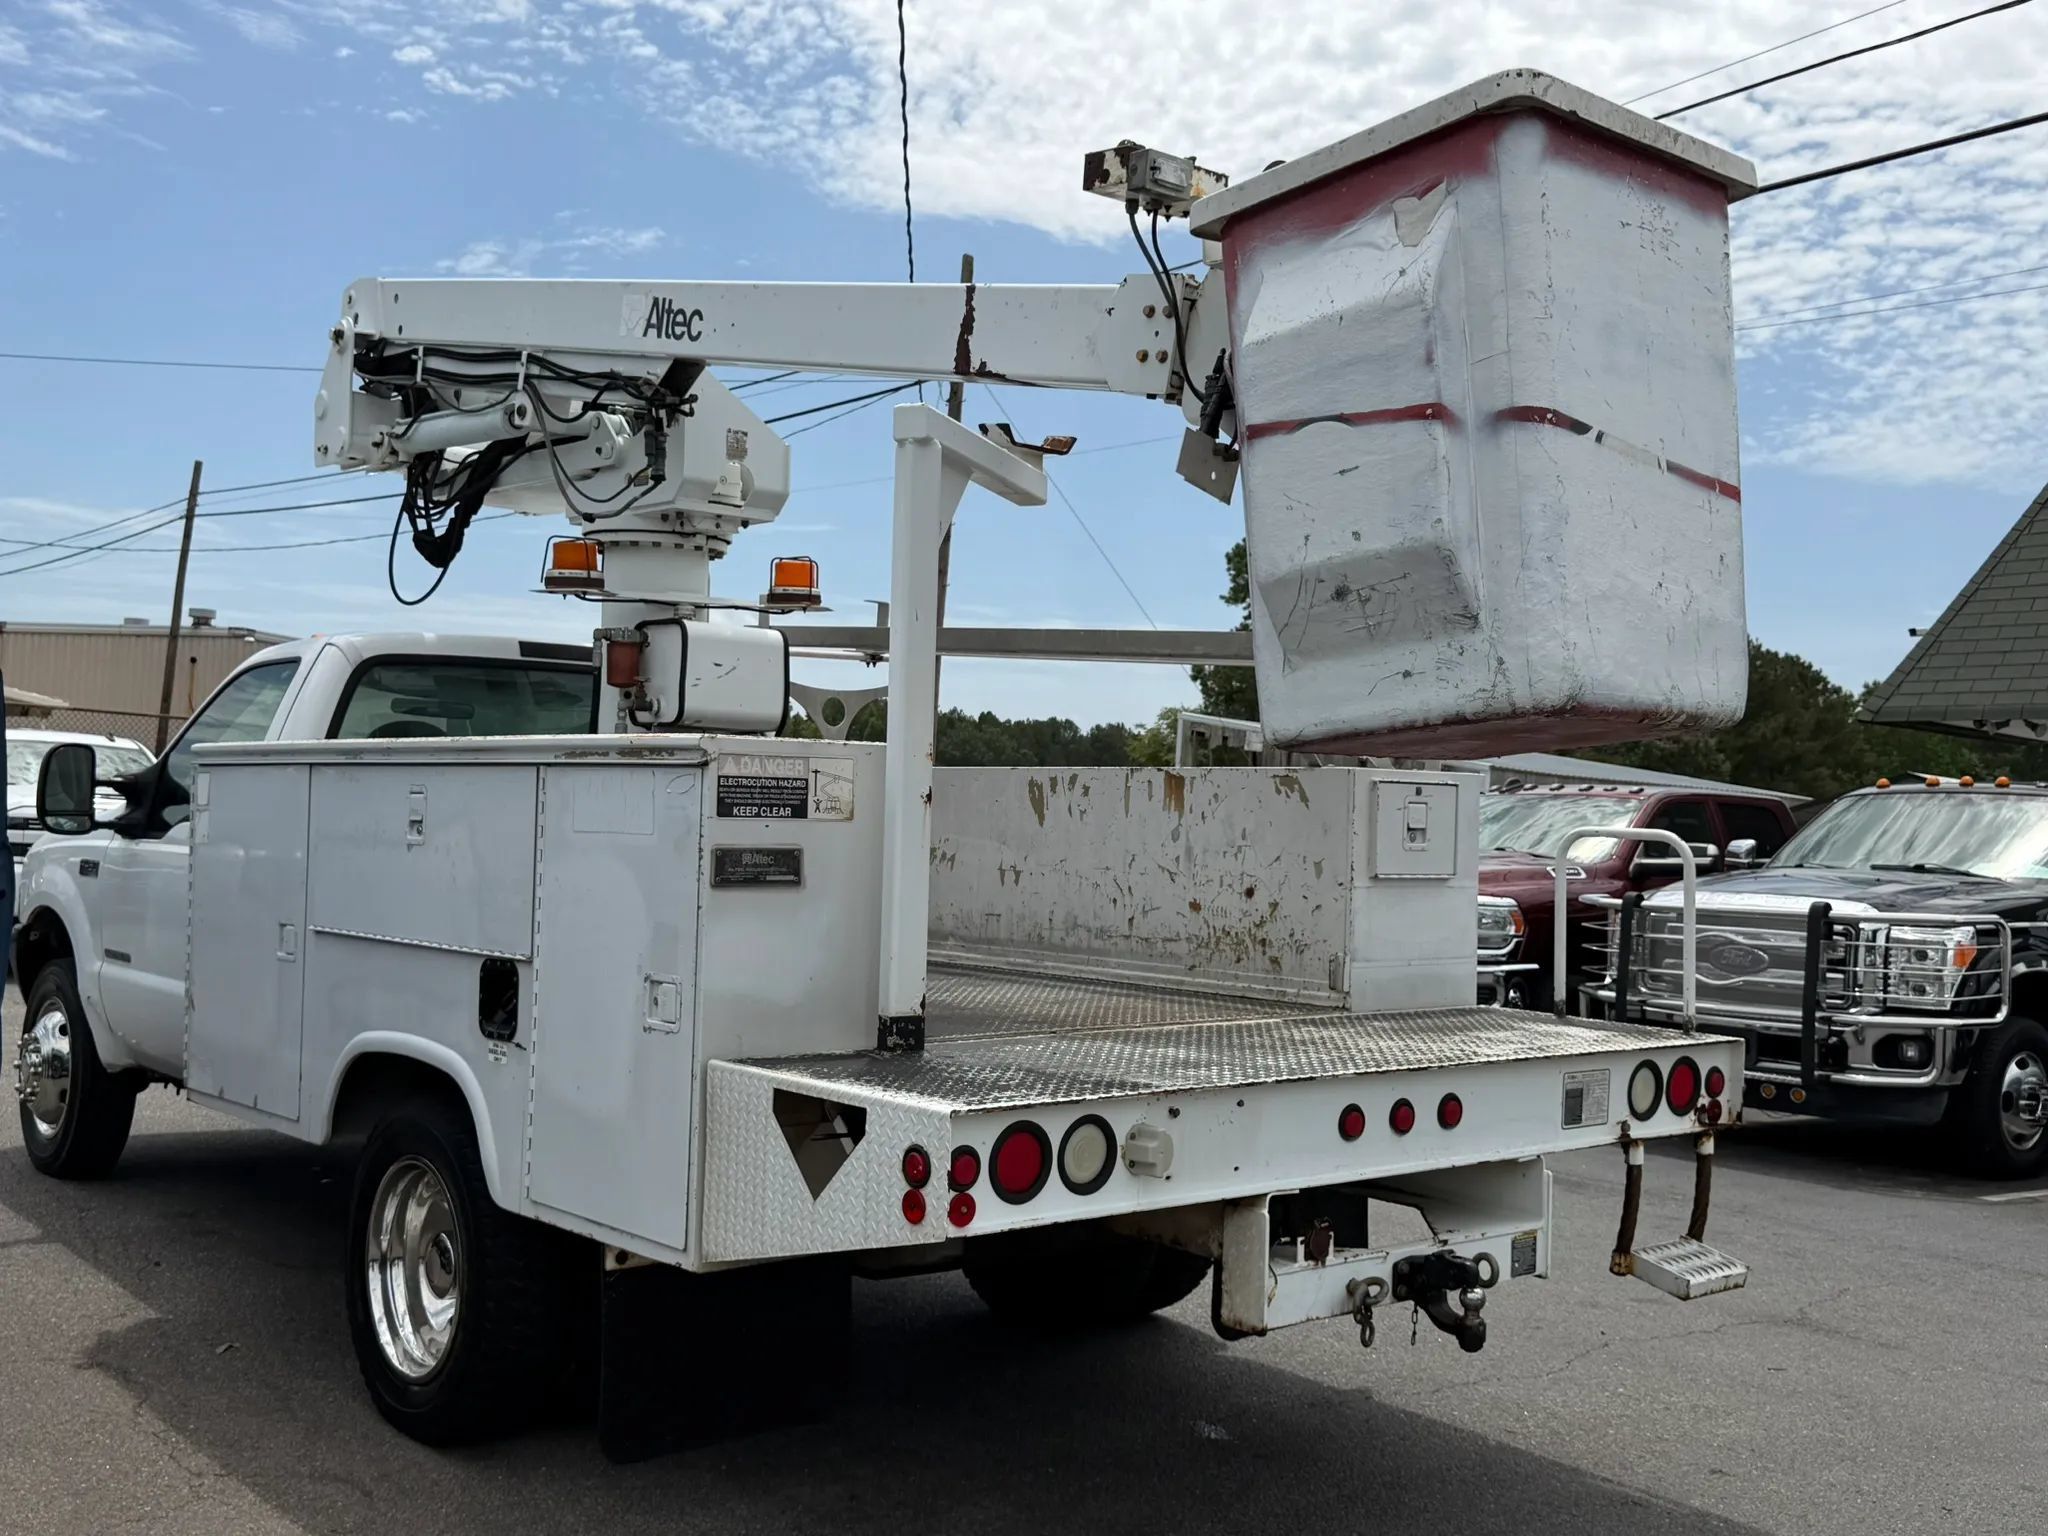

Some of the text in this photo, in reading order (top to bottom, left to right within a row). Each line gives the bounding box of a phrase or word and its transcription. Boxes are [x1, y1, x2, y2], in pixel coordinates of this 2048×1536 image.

[642, 296, 704, 342] Altec
[740, 756, 804, 775] DANGER
[720, 778, 806, 788] ELECTROCUTION HAZARD
[733, 806, 792, 817] KEEP CLEAR
[752, 852, 775, 864] Altec
[1721, 948, 1753, 967] Ford
